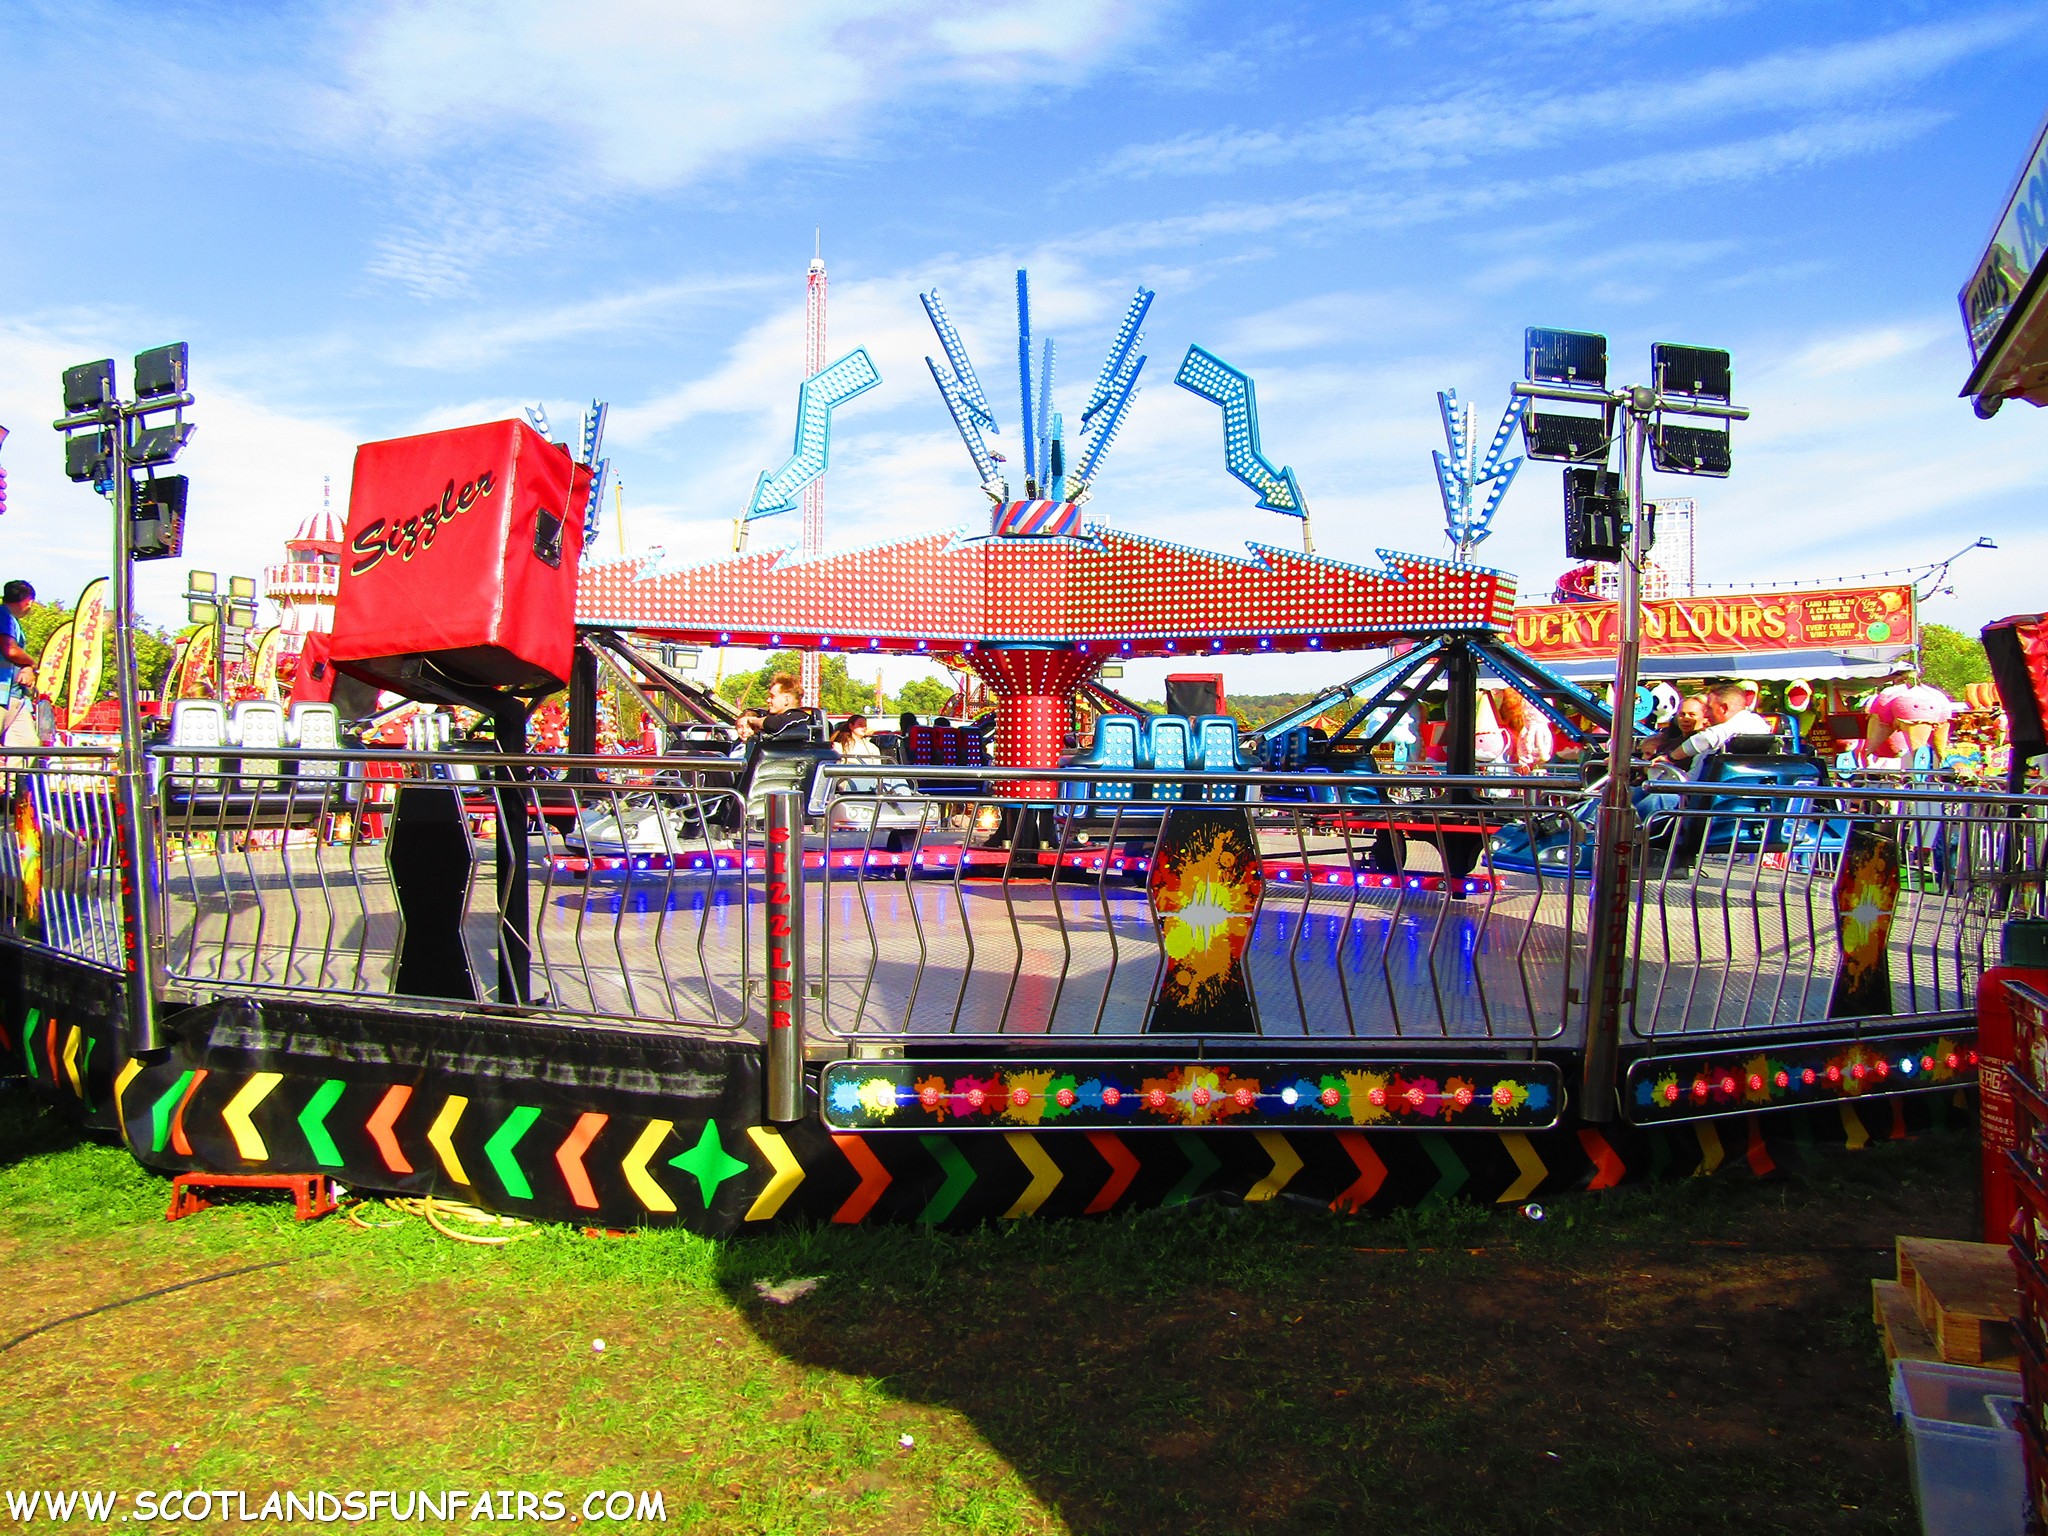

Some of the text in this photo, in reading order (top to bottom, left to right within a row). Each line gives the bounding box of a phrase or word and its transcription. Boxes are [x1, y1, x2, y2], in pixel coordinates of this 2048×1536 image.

[351, 470, 497, 577] Sizzler
[1638, 605, 1786, 640] OLOURS
[1829, 622, 1855, 630] COLOUR
[769, 827, 792, 1029] SIZZLER
